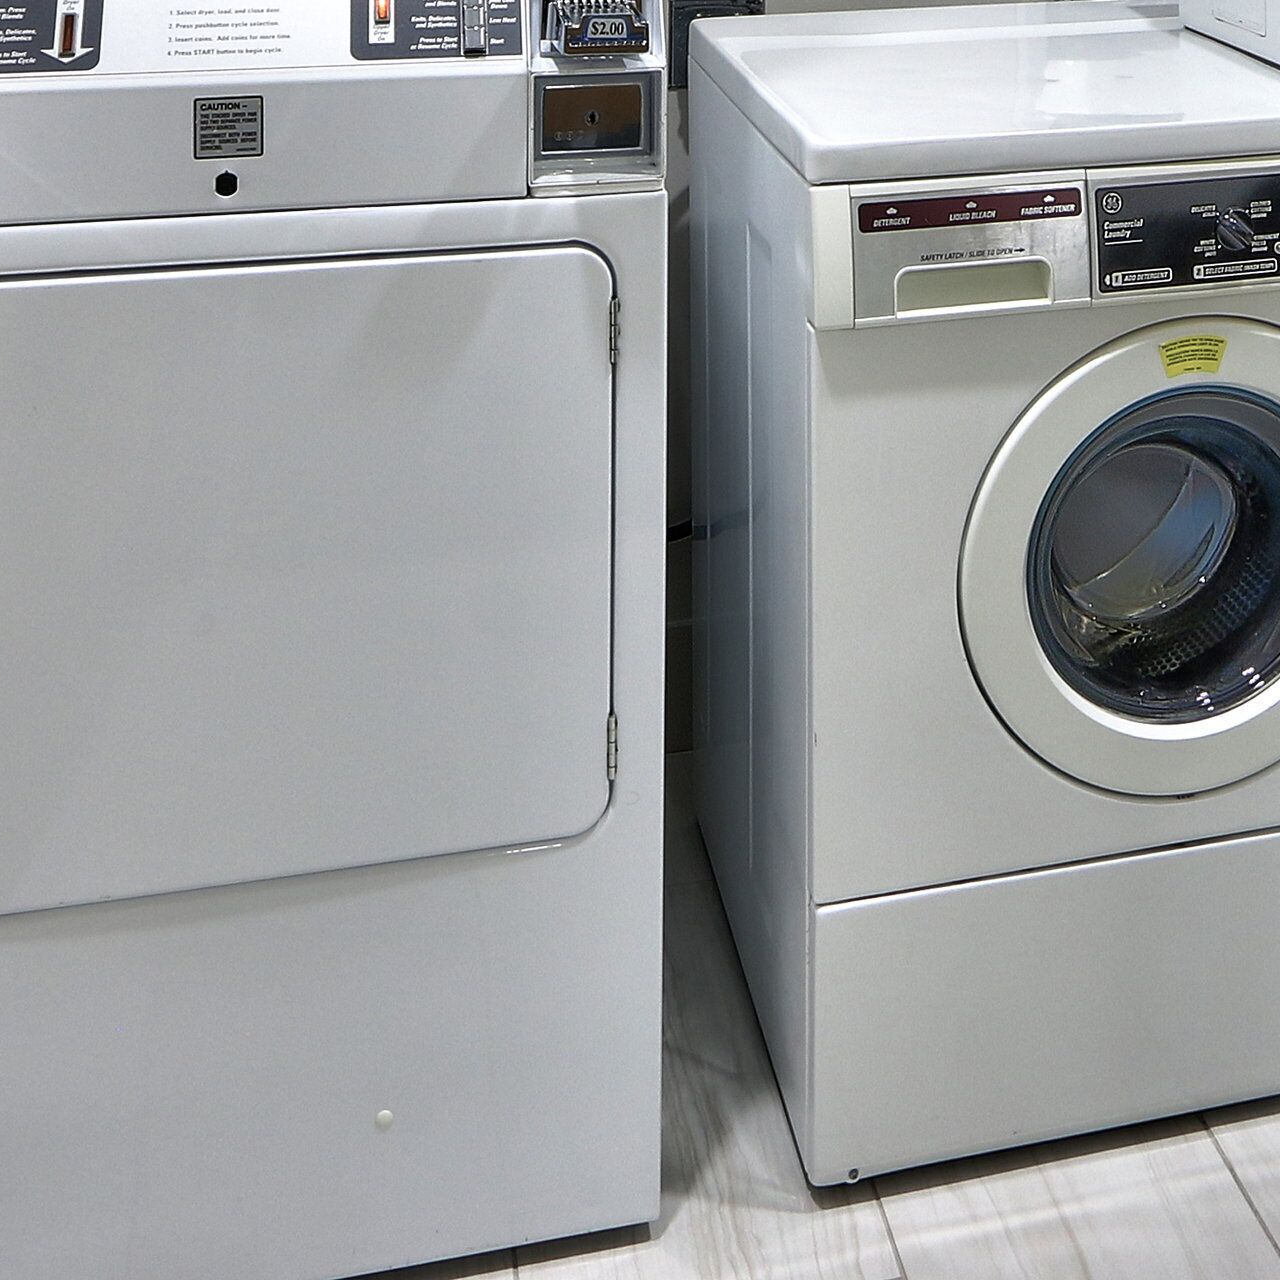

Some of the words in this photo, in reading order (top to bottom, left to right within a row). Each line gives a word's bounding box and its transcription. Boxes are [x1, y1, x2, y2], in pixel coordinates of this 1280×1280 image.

[590, 21, 625, 36] $2.00
[200, 102, 240, 112] CAUTION
[1020, 205, 1043, 216] FABRIC
[1044, 203, 1076, 215] SOFTENER
[872, 216, 911, 228] DETERGENT
[948, 211, 970, 222] LIQUID
[971, 210, 997, 220] BLEACH
[1103, 218, 1144, 230] Commercial
[1104, 228, 1132, 239] Laundry
[920, 254, 944, 262] SAFETY
[944, 252, 965, 260] LATCH
[969, 250, 987, 258] SLIDE
[988, 249, 996, 257] TO
[996, 248, 1014, 256] OPEN
